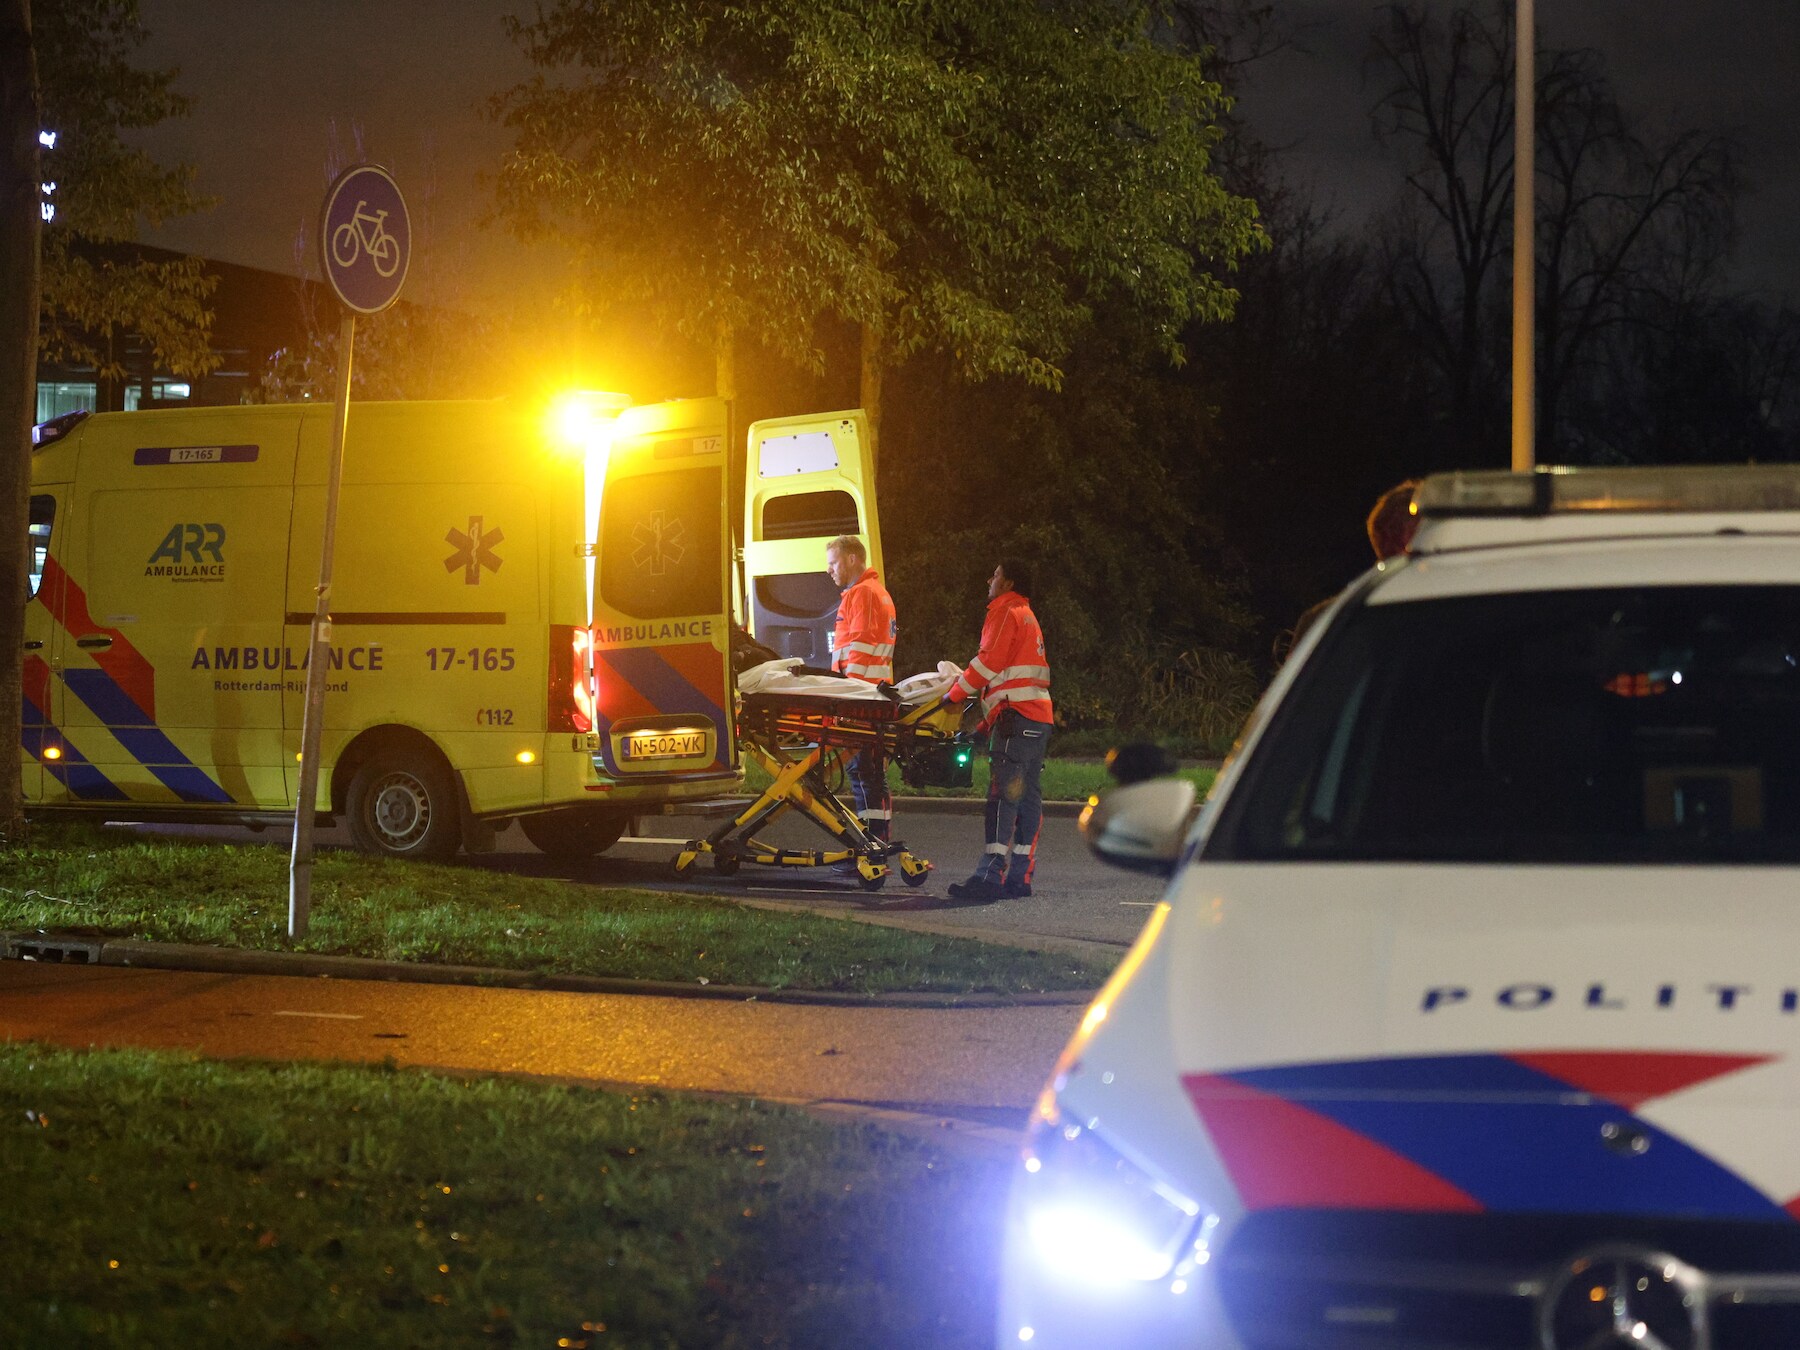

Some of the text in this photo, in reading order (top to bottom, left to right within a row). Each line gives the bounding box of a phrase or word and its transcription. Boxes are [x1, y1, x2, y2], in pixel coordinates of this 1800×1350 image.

[179, 449, 213, 460] 17-165
[148, 523, 226, 564] ARR
[144, 565, 225, 577] AMBULANCE
[594, 621, 712, 643] AMBULANCE
[426, 647, 515, 672] 17-165
[214, 680, 348, 694] Rotterdam-Rijond
[633, 736, 701, 755] N-502-VK
